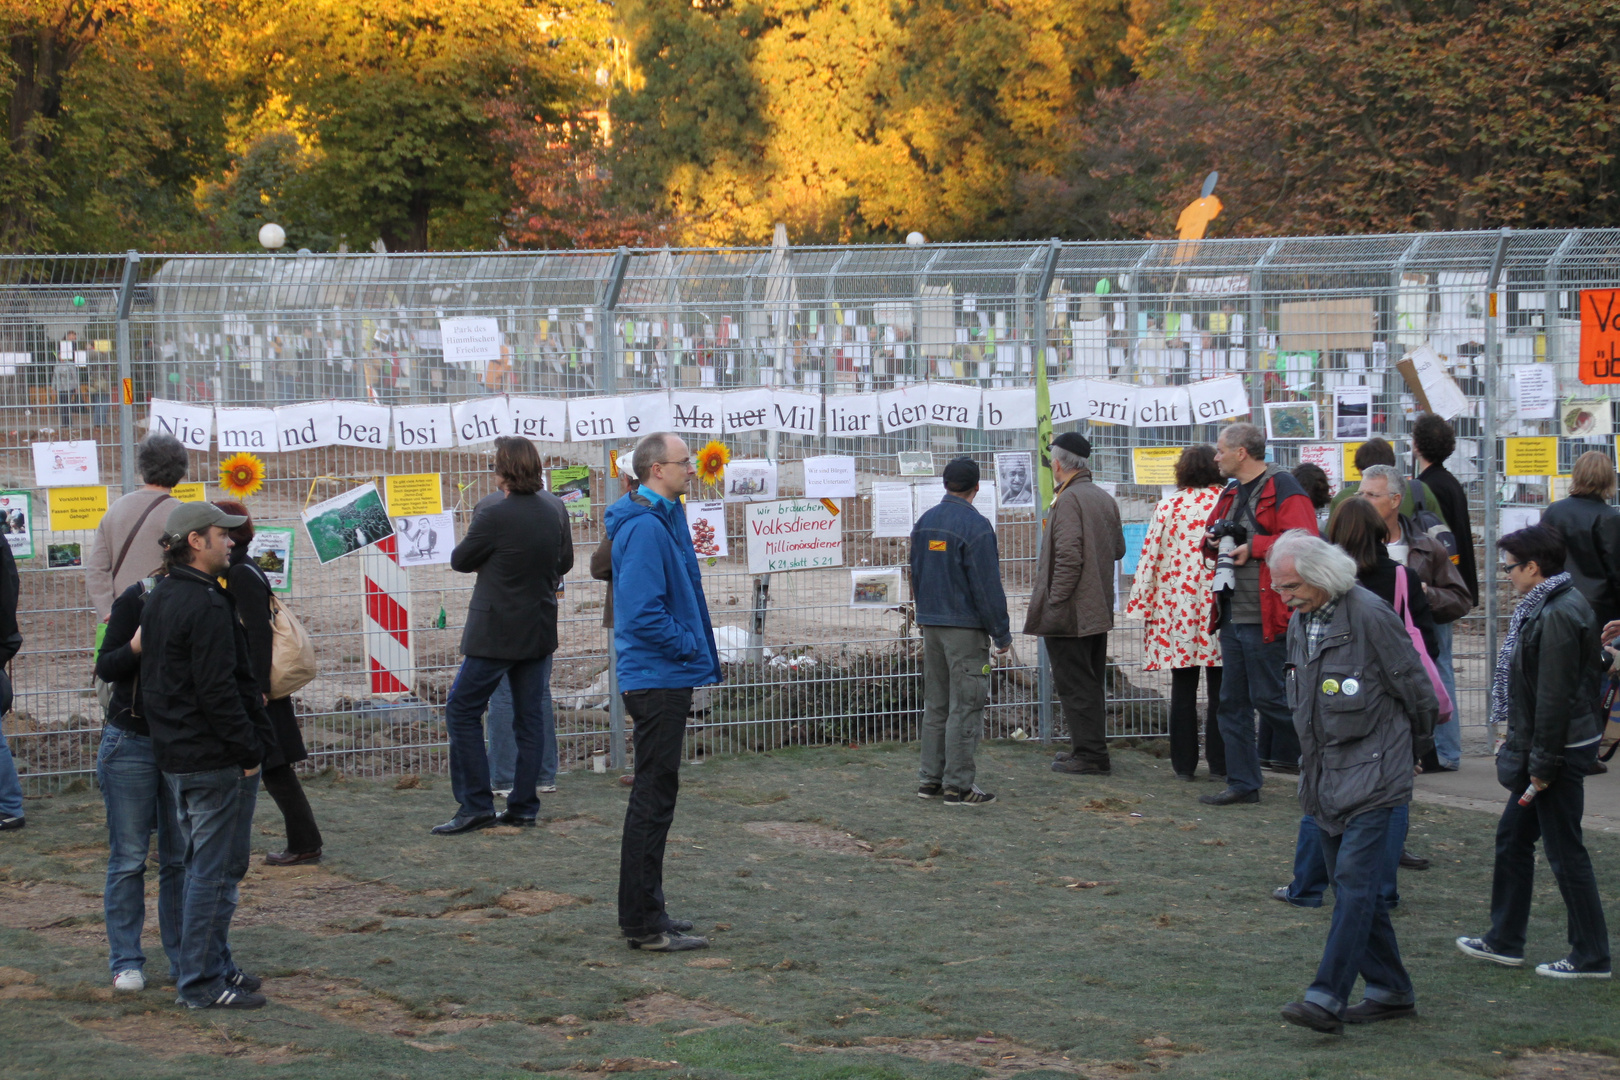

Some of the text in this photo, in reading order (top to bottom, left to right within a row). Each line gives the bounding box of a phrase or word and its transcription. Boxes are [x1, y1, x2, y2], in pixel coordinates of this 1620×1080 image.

[446, 336, 495, 344] Himmlischen
[456, 346, 488, 354] Friedens
[1050, 401, 1072, 420] zu
[778, 503, 824, 515] brauchen
[752, 516, 836, 535] Volksdiener
[769, 557, 833, 571] K 21 statt S 21
